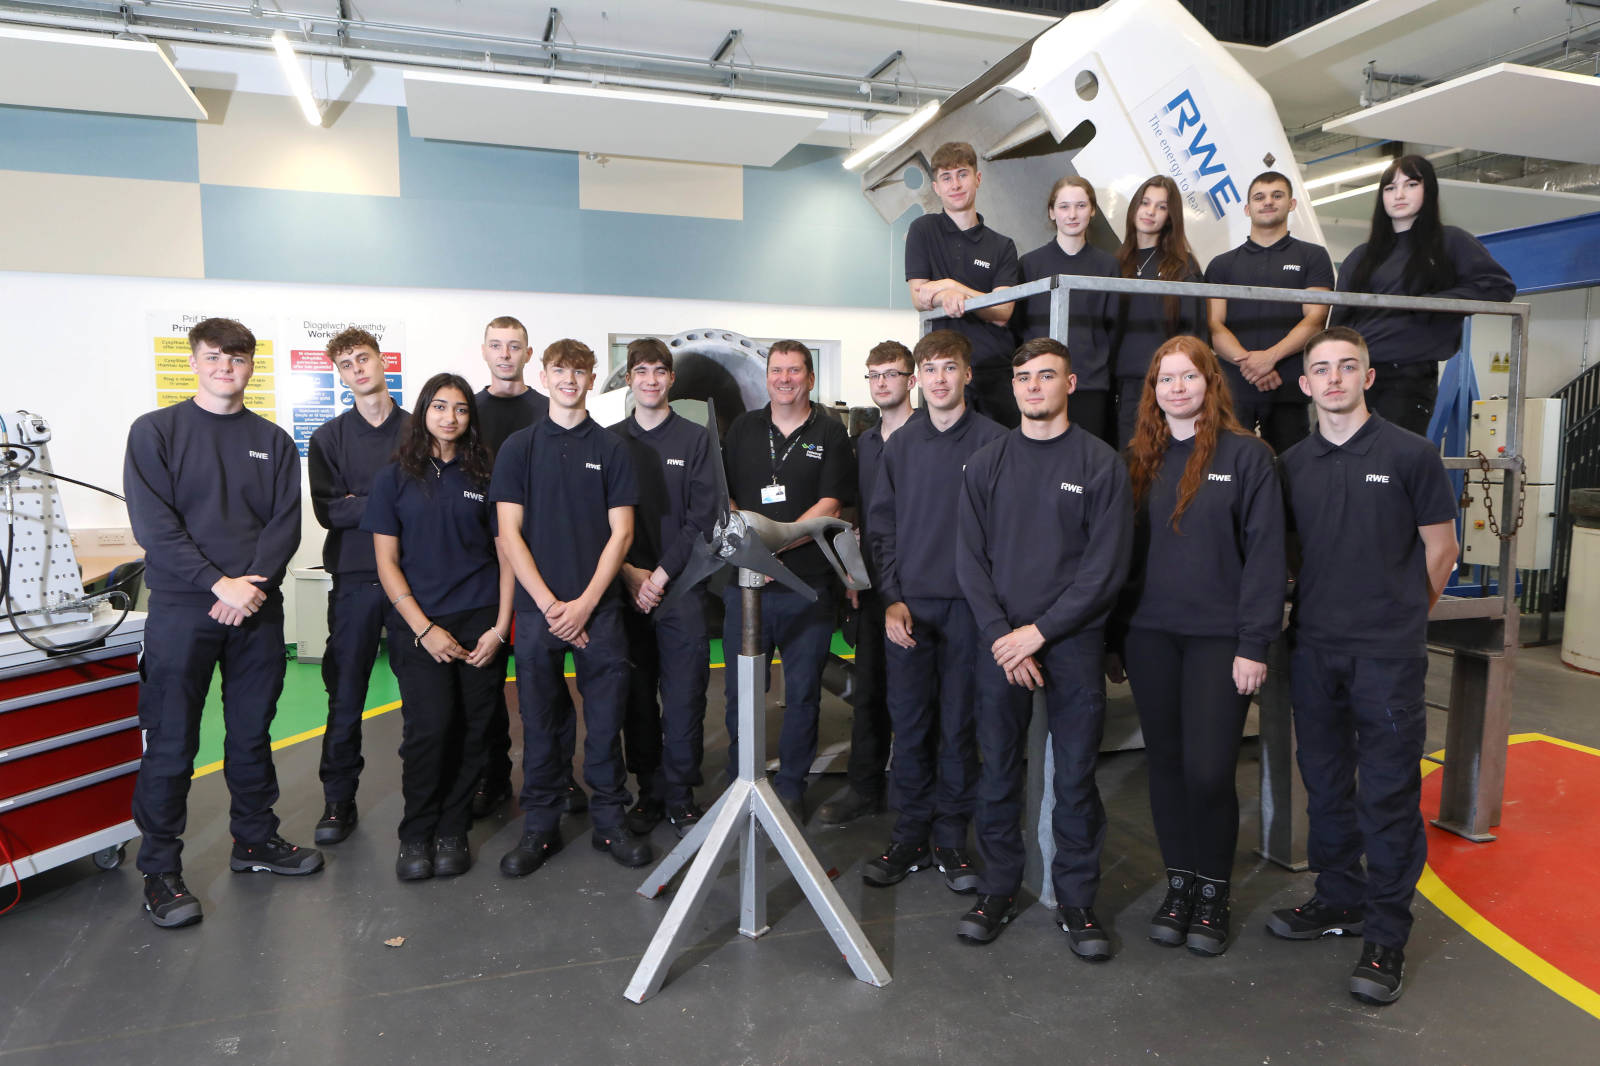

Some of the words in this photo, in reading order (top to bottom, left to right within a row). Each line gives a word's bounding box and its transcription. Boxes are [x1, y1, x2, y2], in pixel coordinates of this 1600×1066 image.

[1148, 114, 1164, 138] The
[1159, 138, 1183, 178] energy
[1180, 177, 1190, 192] to
[1166, 88, 1242, 218] RWE
[973, 258, 991, 269] RWE
[1282, 264, 1301, 272] RWE
[248, 450, 270, 460] RWE
[585, 462, 602, 471] RWE
[666, 458, 686, 467] RWE
[1207, 473, 1232, 482] RWE
[1365, 474, 1390, 484] RWE
[1060, 482, 1085, 494] RWE
[463, 490, 485, 502] RWE
